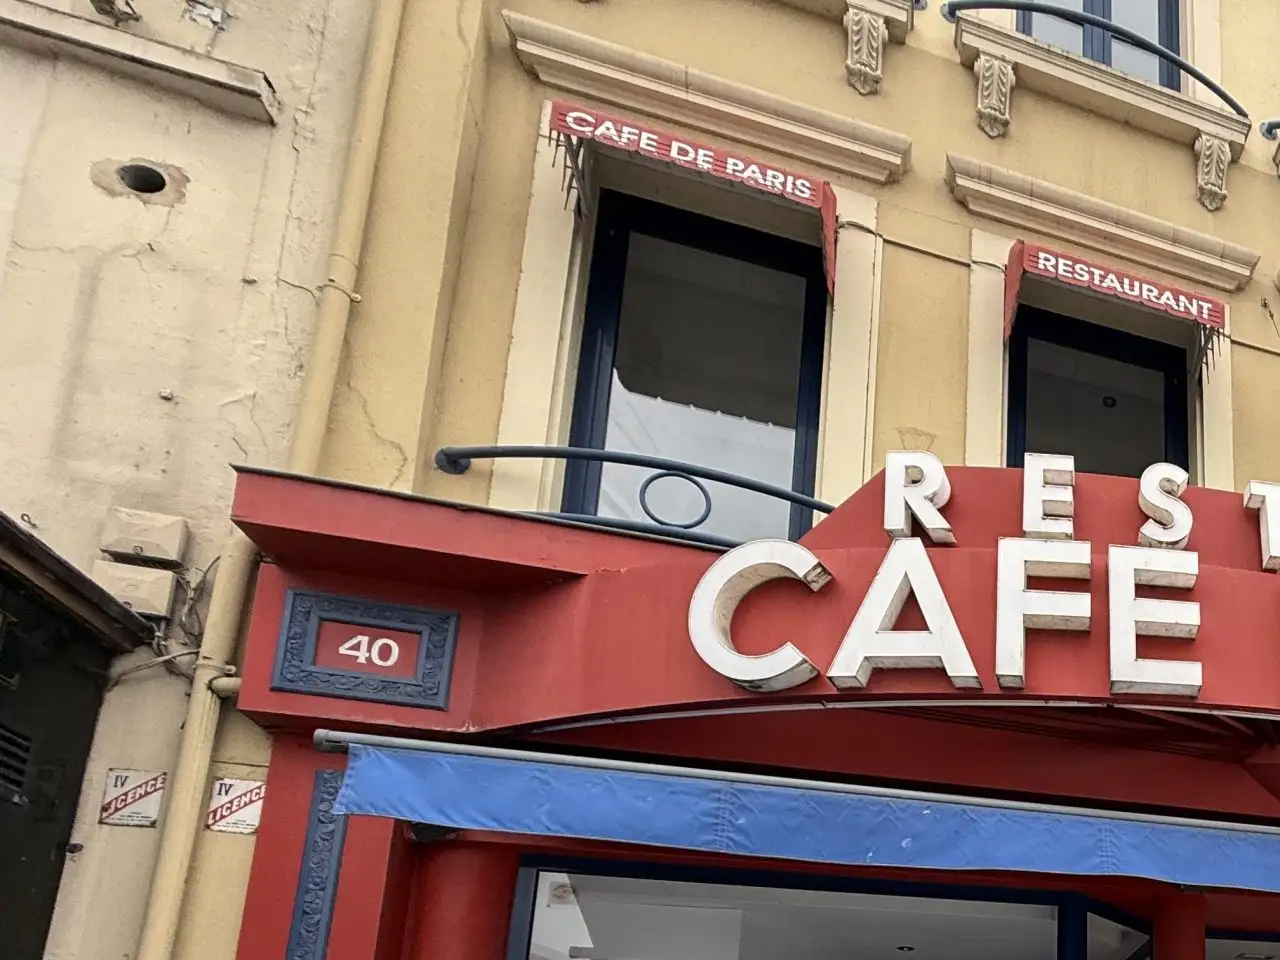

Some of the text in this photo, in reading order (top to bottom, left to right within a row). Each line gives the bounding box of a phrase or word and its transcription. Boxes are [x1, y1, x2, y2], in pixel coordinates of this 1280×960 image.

[565, 111, 814, 199] CAFE DE PARIS
[1037, 251, 1213, 320] RESTAURANT
[688, 537, 1204, 698] CAFE
[338, 634, 400, 667] 40
[113, 774, 130, 789] IV
[217, 782, 234, 797] IV
